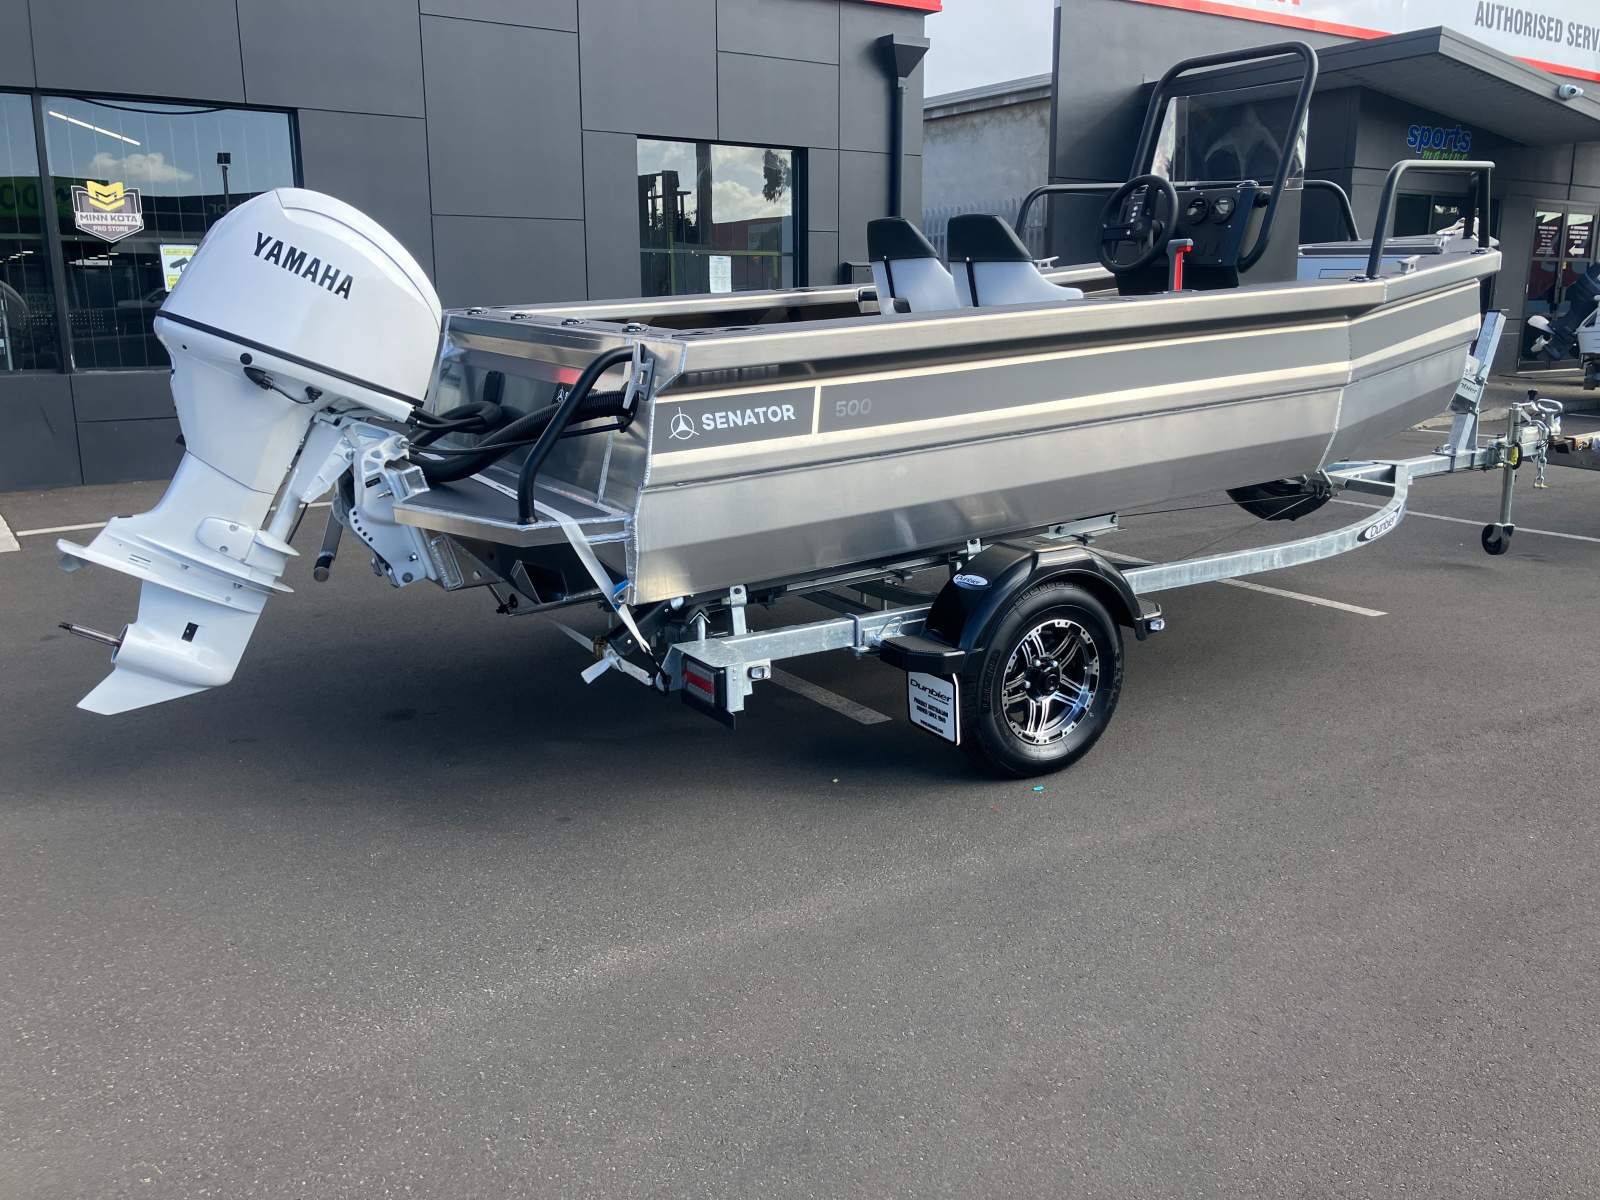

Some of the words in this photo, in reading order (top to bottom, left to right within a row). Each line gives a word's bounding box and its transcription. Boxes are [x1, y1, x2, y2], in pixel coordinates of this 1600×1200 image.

[1475, 1, 1563, 43] AUTHORISED
[1567, 21, 1600, 53] SERV
[1407, 124, 1472, 153] sports
[80, 213, 107, 223] MINN
[110, 214, 138, 223] KOTA
[253, 231, 354, 300] YAMAHA
[701, 404, 796, 431] SENATOR
[835, 398, 872, 417] 500
[910, 678, 952, 702] Dunbier
